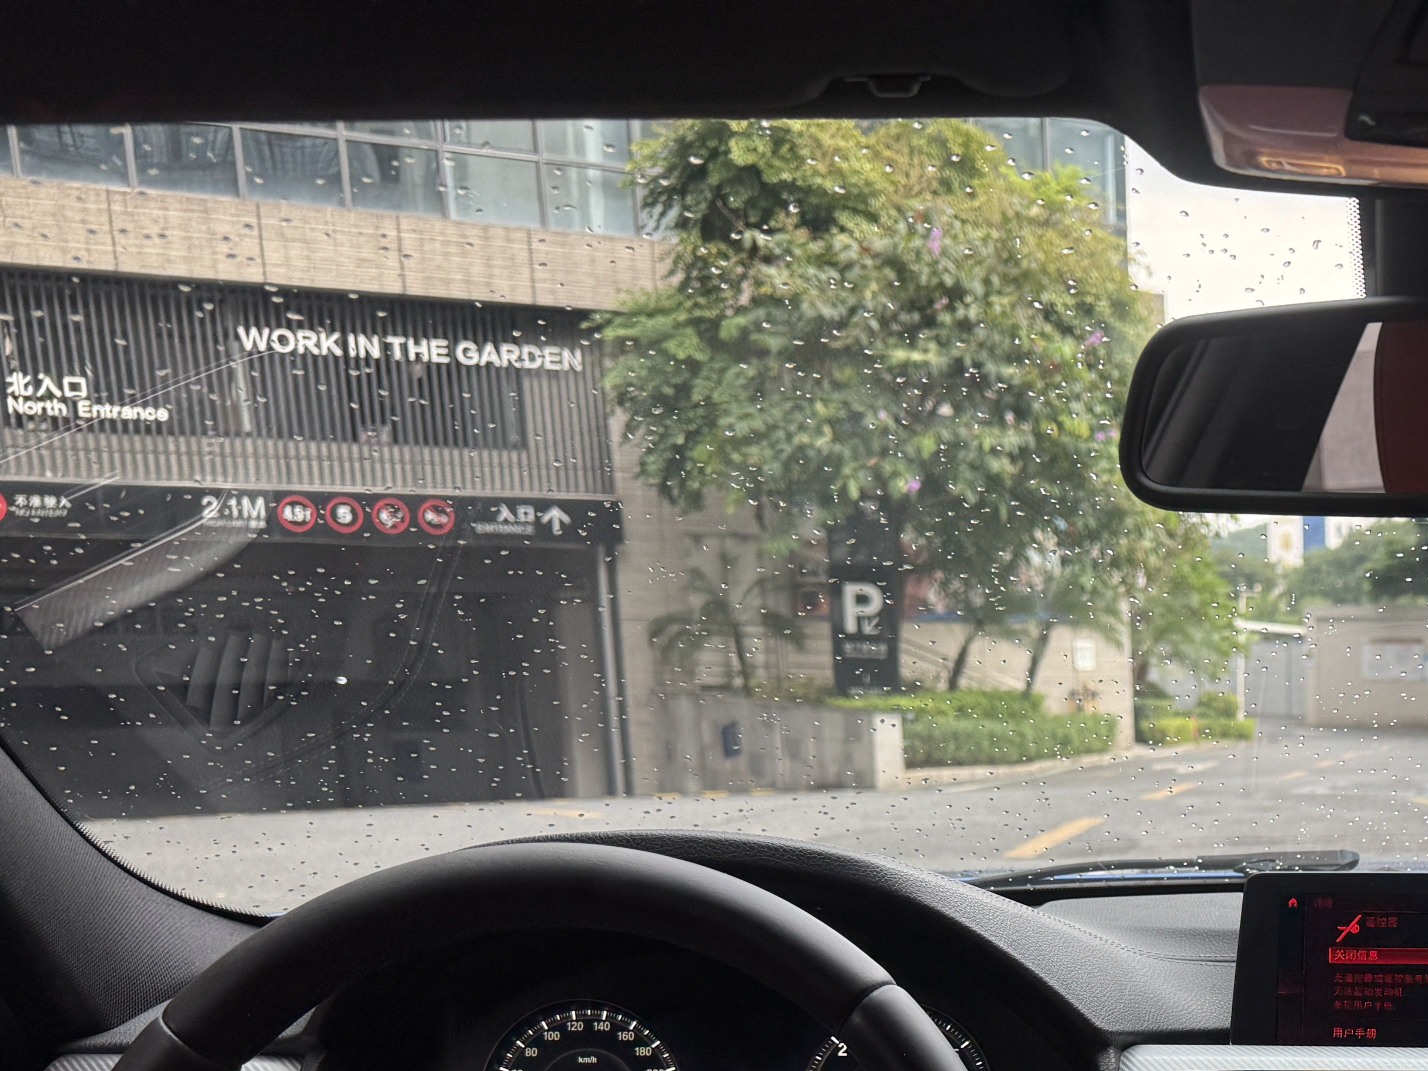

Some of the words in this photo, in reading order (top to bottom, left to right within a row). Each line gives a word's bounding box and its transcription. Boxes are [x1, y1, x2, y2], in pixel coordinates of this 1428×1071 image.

[237, 325, 343, 357] WORK
[349, 333, 380, 359] IN
[385, 335, 450, 364] THE
[456, 340, 583, 372] GARDEN
[5, 371, 87, 398] 北入口
[7, 397, 67, 417] North
[77, 400, 169, 422] Entrance
[201, 495, 266, 519] 2.1M
[496, 503, 536, 522] 入口
[842, 581, 884, 634] P
[1334, 950, 1378, 961] 关闭信息
[566, 1021, 583, 1031] 120
[593, 1021, 611, 1031] 140
[543, 1031, 560, 1041] 100
[617, 1031, 634, 1041] 160
[1332, 1027, 1377, 1039] 用户手册
[525, 1047, 538, 1057] 80
[635, 1047, 652, 1057] 180
[838, 1042, 848, 1057] 2
[578, 1055, 597, 1064] km/h
